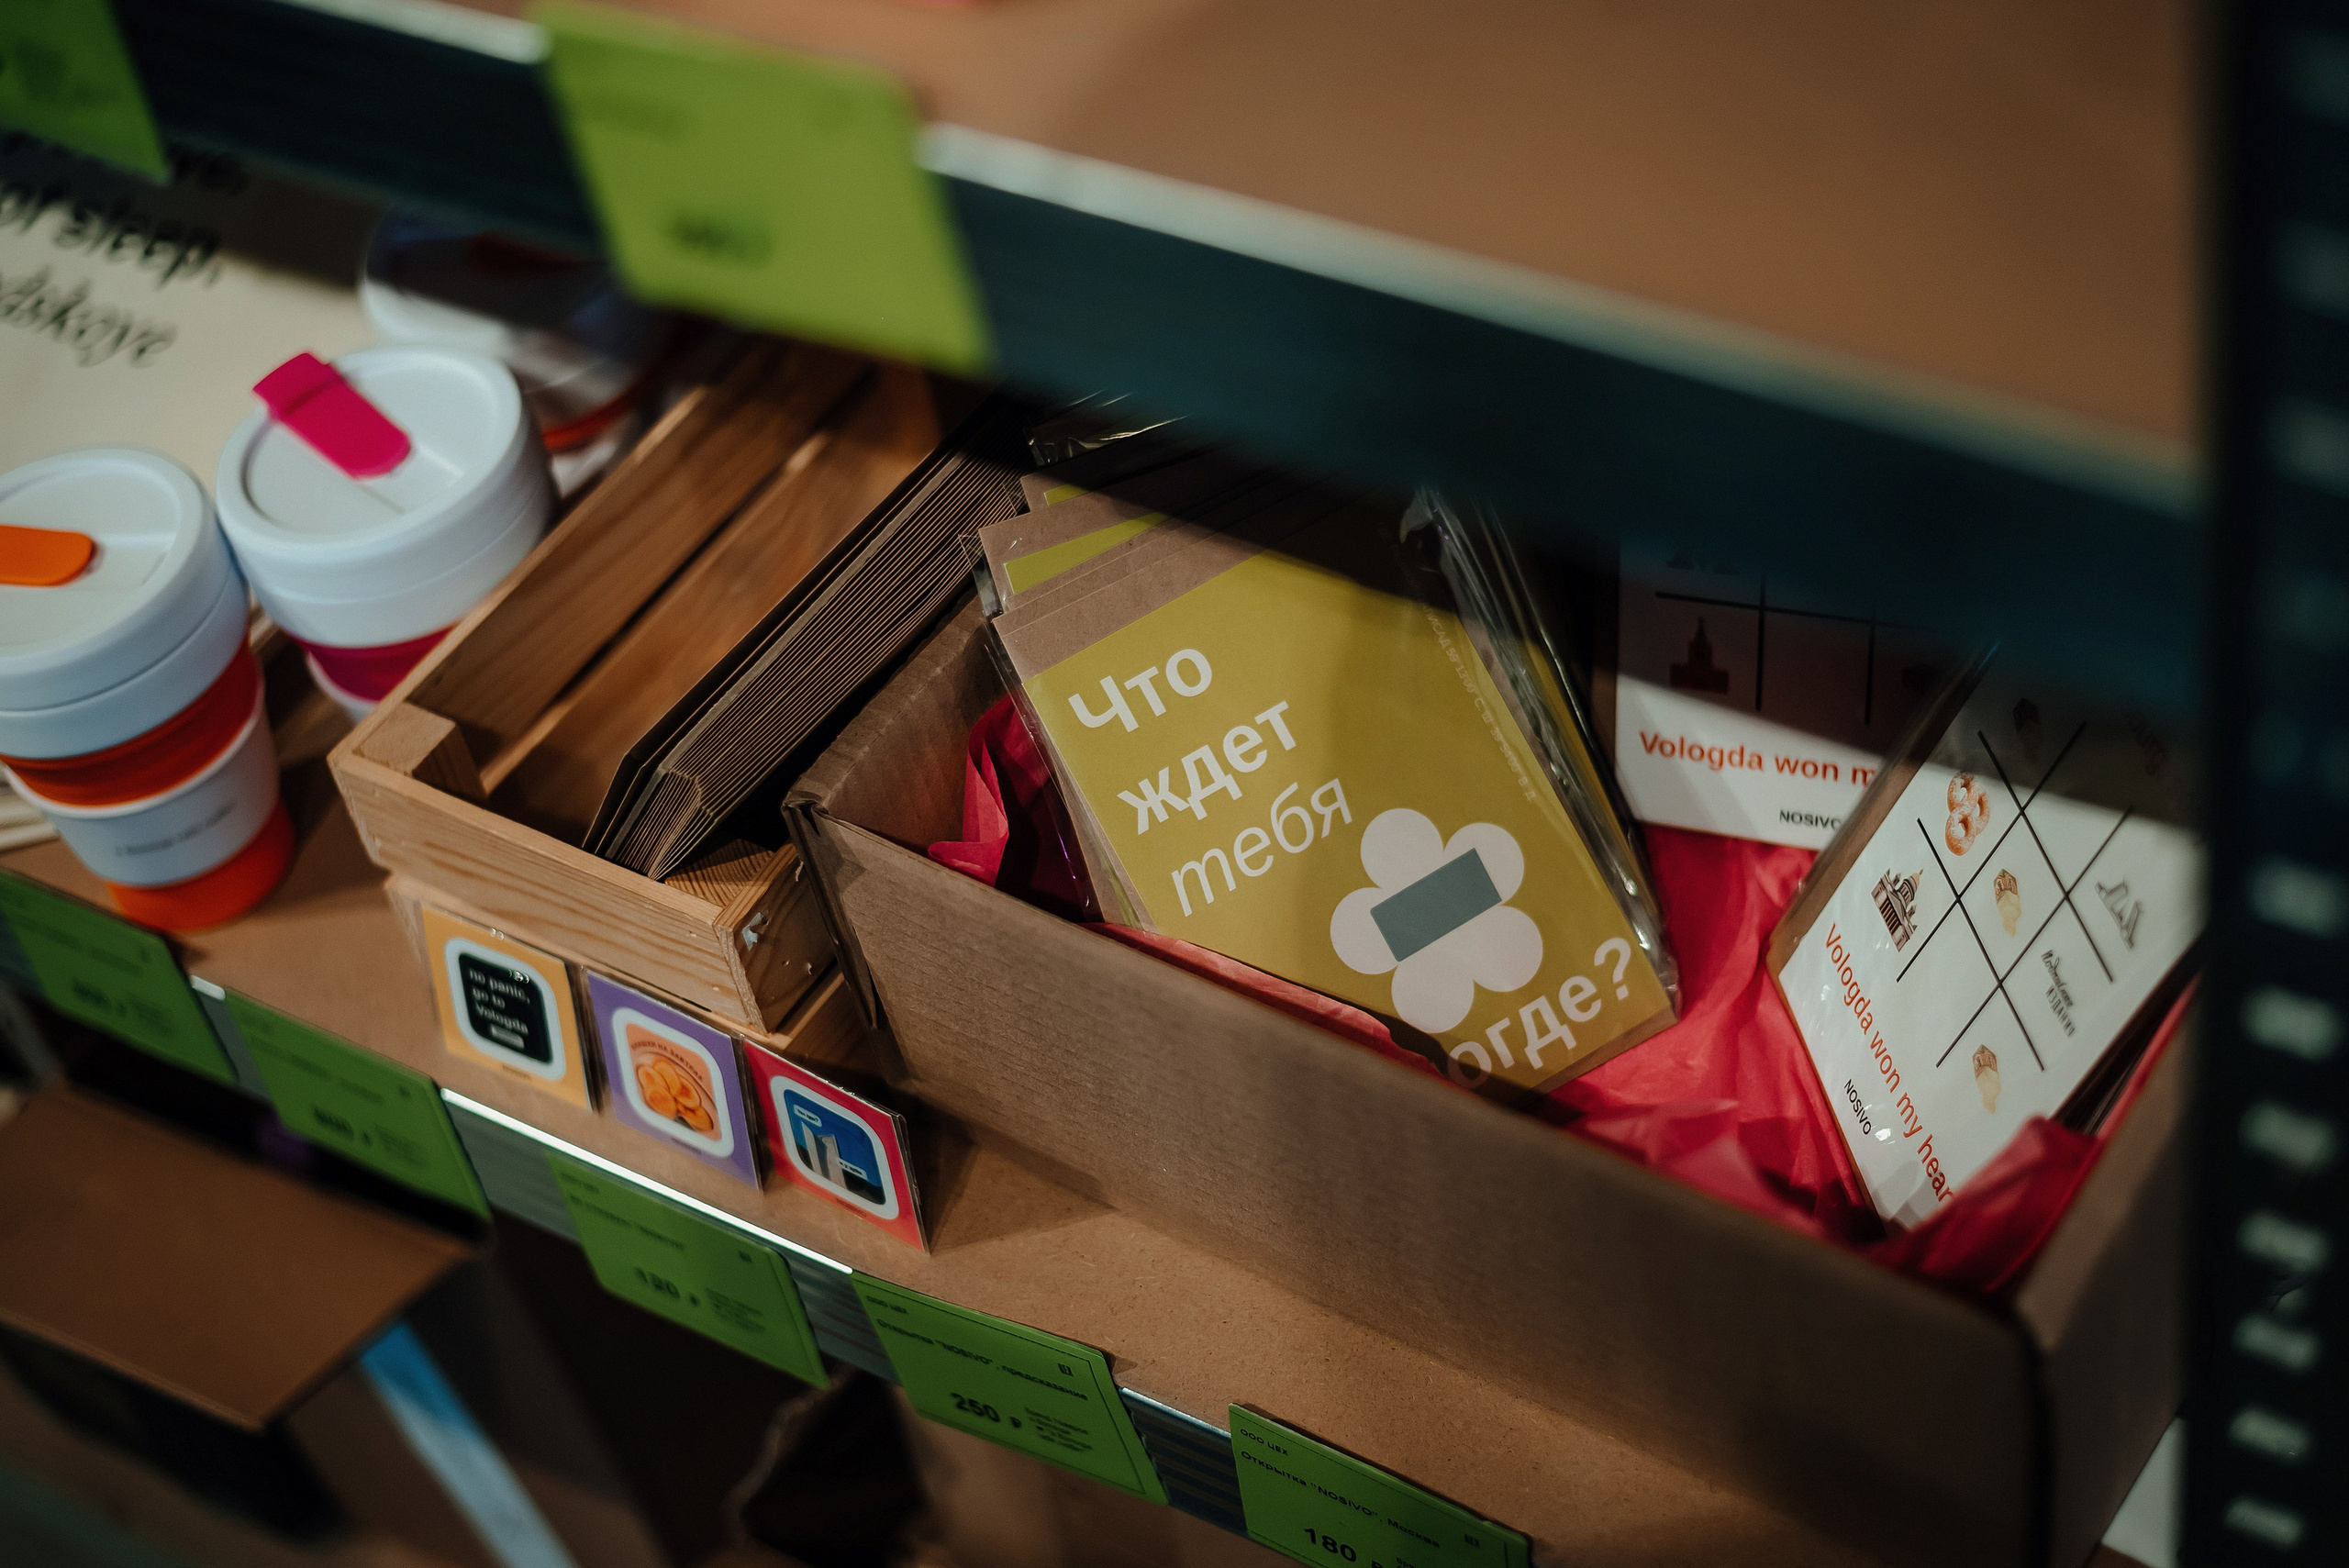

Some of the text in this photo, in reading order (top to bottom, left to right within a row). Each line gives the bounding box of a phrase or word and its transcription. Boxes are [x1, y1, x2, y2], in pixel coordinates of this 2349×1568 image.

[1068, 648, 1213, 733] Что
[1117, 700, 1297, 835] ждет
[1639, 730, 1876, 786] Vologda won m
[1171, 779, 1353, 917] тебя
[1825, 922, 1954, 1203] Vologda won my hear
[1843, 1079, 1872, 1135] NOSIVO
[950, 1392, 1001, 1422] 250
[1267, 1441, 1289, 1457] ЦЕХ
[1241, 1451, 1307, 1487] Открытка
[1387, 1518, 1441, 1549] Москва
[1304, 1528, 1357, 1563] 180
